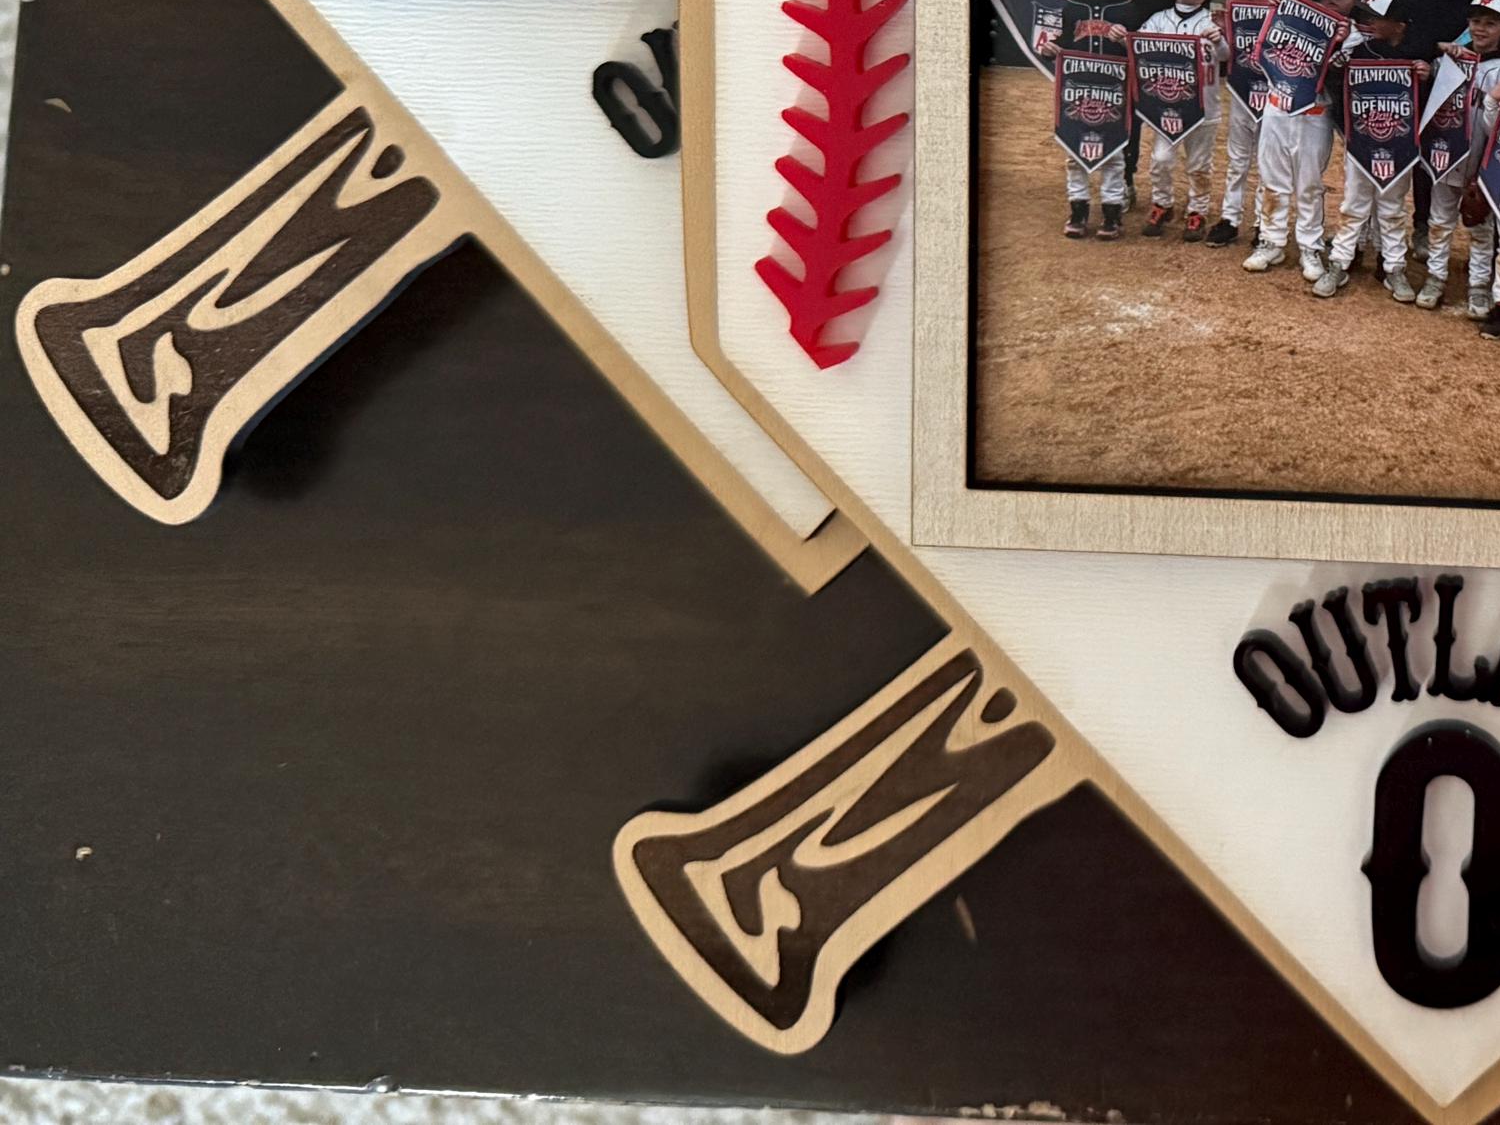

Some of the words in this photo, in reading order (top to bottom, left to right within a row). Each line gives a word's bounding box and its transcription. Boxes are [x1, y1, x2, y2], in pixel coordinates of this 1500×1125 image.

[1277, 0, 1337, 38] CHAMPIONS
[1134, 39, 1196, 59] CHAMPIONS
[1269, 28, 1326, 63] OPENING
[1063, 59, 1126, 81] CHAMPIONS
[1139, 66, 1196, 84] OPENING
[1349, 69, 1412, 88] CHAMPIONS
[1064, 88, 1124, 106] OPENING
[1352, 100, 1411, 117] OPENING
